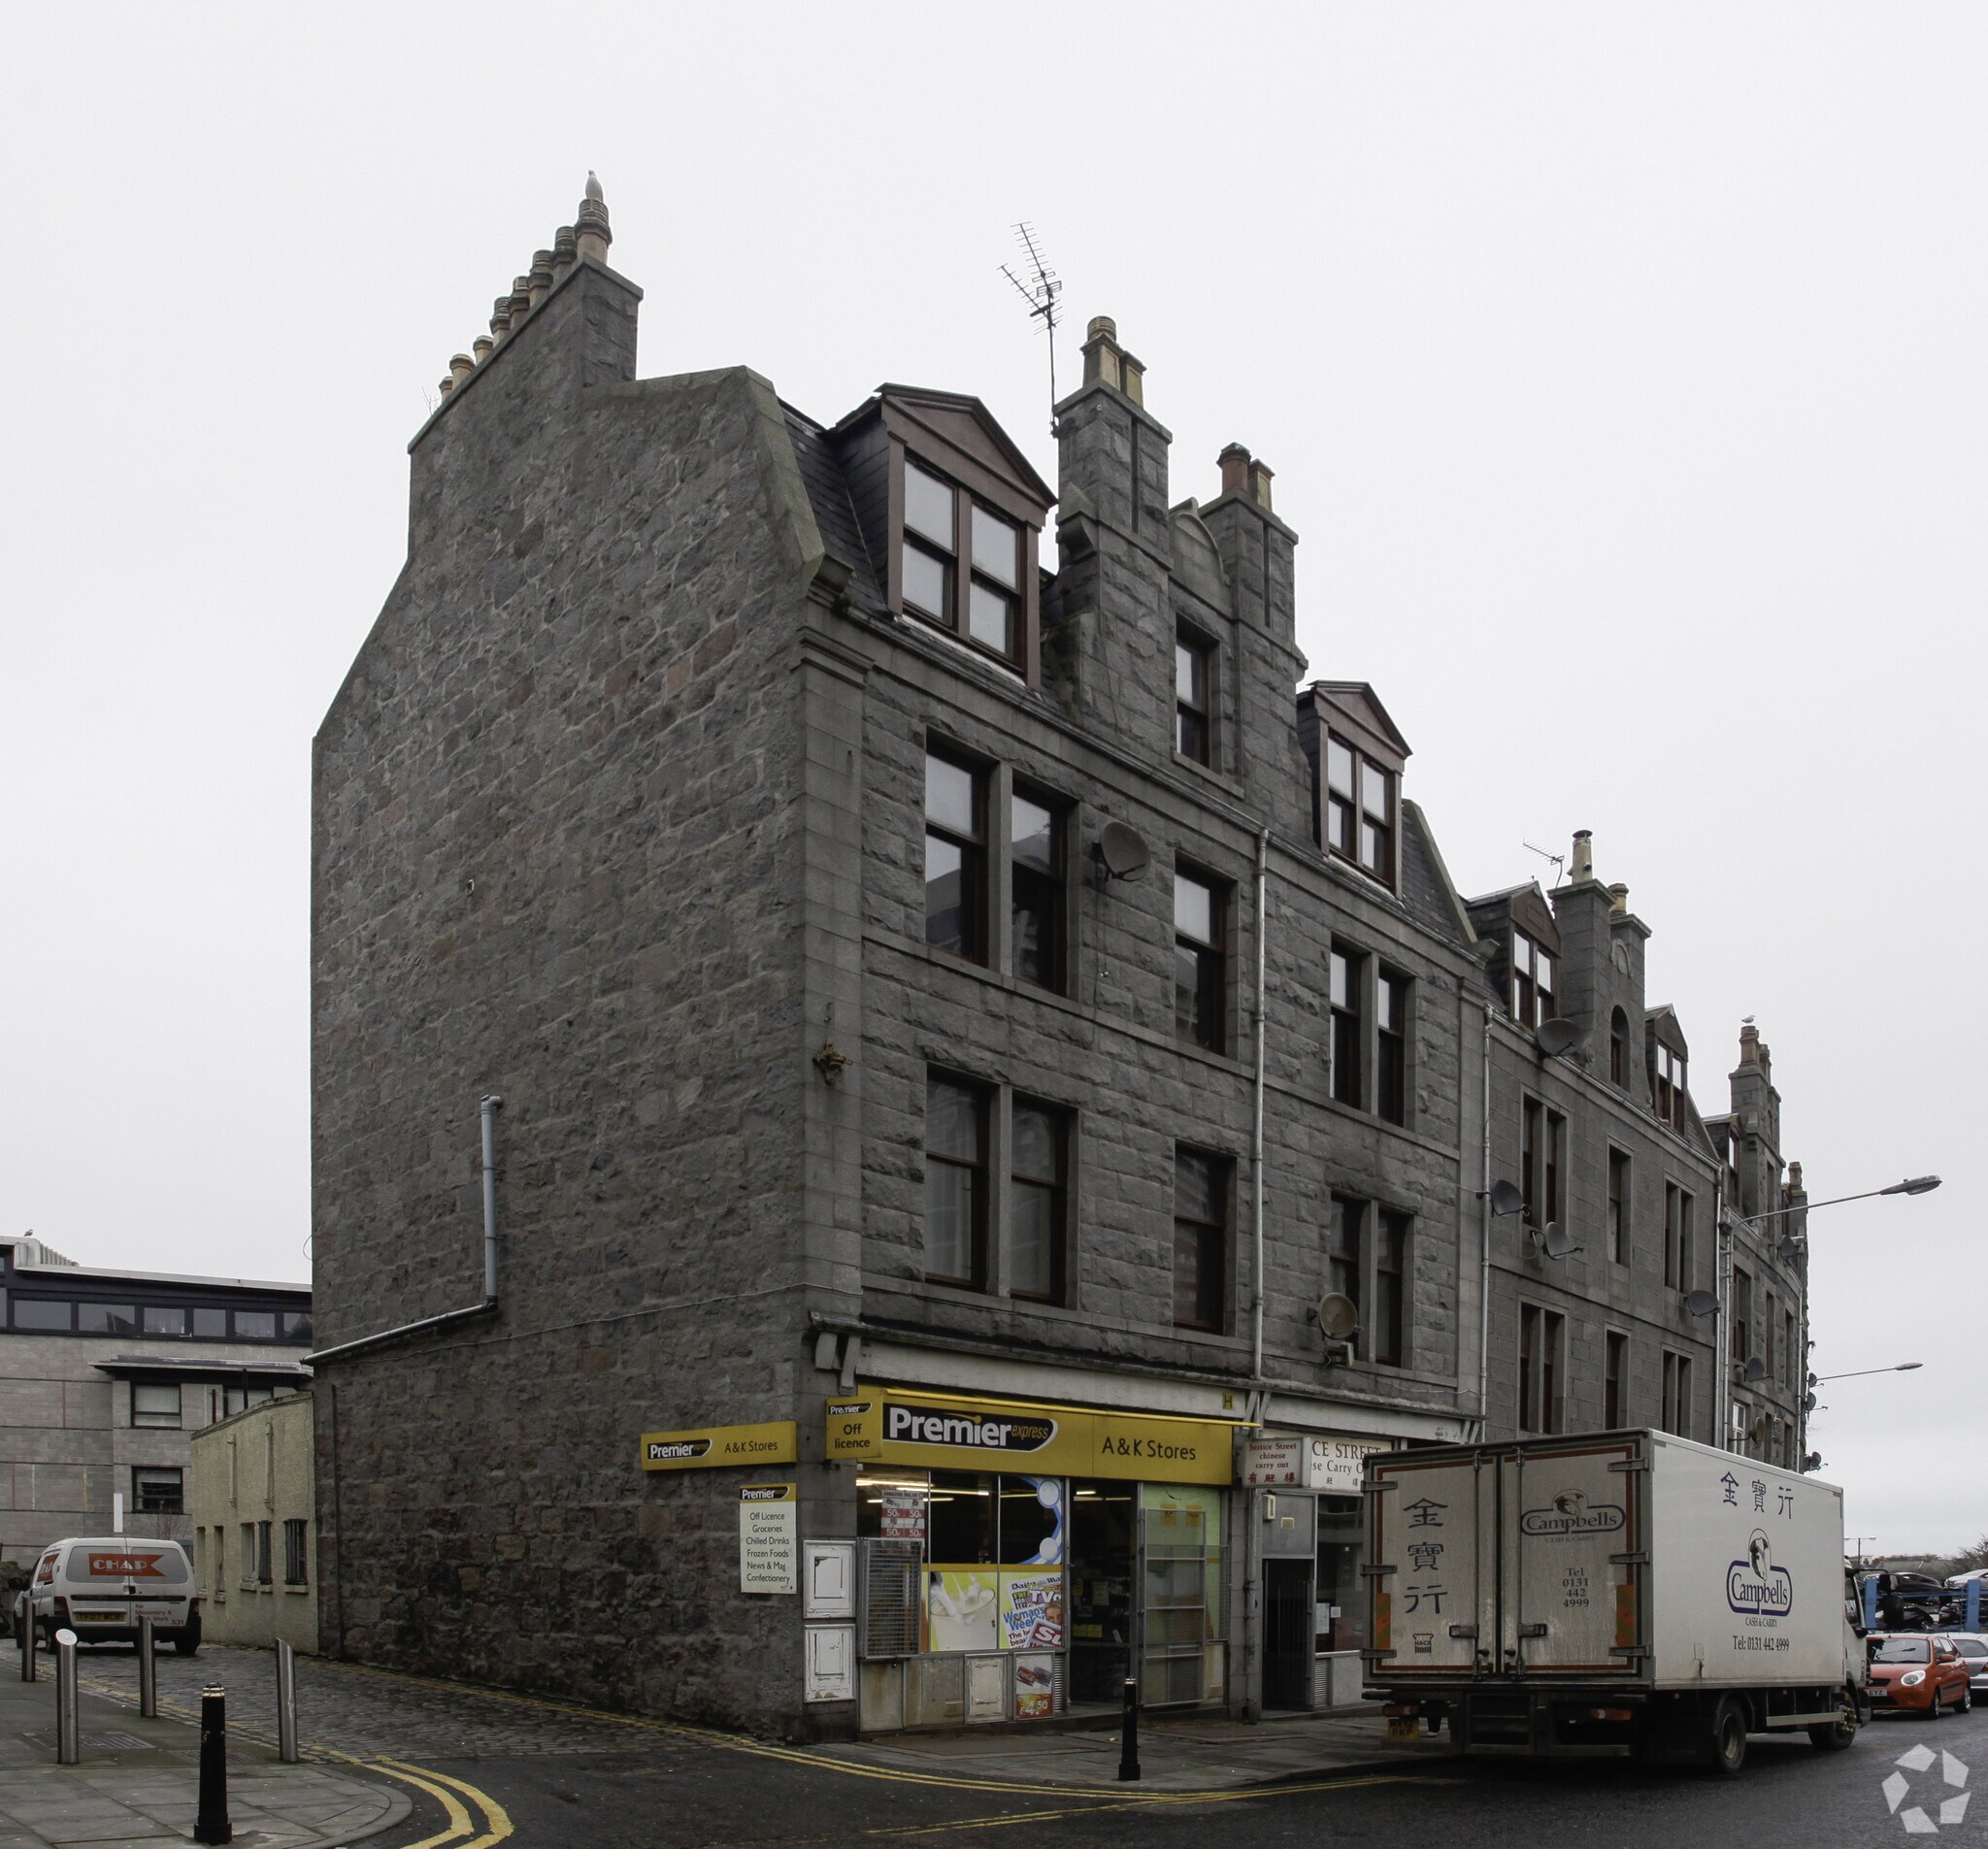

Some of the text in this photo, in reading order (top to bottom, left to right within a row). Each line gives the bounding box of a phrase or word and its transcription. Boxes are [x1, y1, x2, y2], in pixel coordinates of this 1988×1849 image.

[830, 1404, 859, 1415] Premier
[844, 1424, 861, 1436] Off
[889, 1407, 1048, 1447] Premier express
[835, 1438, 870, 1450] licence
[1102, 1436, 1195, 1461] A & K Stores
[1249, 1442, 1273, 1451] Justice
[649, 1443, 693, 1459] Premier
[724, 1443, 731, 1454] A
[732, 1443, 740, 1454] &
[741, 1442, 747, 1453] K
[748, 1441, 779, 1453] Stores
[1326, 1460, 1352, 1475] Carry
[742, 1489, 775, 1500] Premier
[1720, 1471, 1793, 1520] 金寶行
[749, 1512, 784, 1521] Off Licence
[1526, 1512, 1617, 1533] Campbells
[752, 1524, 782, 1534] Groceries
[746, 1536, 789, 1545] Chilled Drinks
[746, 1549, 789, 1558] Frozen Foods
[1403, 1498, 1448, 1614] 金寶行
[93, 1559, 147, 1570] CHAP
[1567, 1568, 1584, 1577] Tel
[746, 1573, 790, 1584] Confectionery
[1562, 1578, 1589, 1587] 0131
[1566, 1589, 1586, 1598] 442
[1731, 1572, 1788, 1611] Campbells
[1563, 1599, 1589, 1607] 4999
[1003, 1606, 1044, 1623] Woman's
[1744, 1616, 1758, 1627] CASH
[1763, 1618, 1777, 1628] CARRY
[1733, 1635, 1789, 1651] Tel: 0131 442 4999
